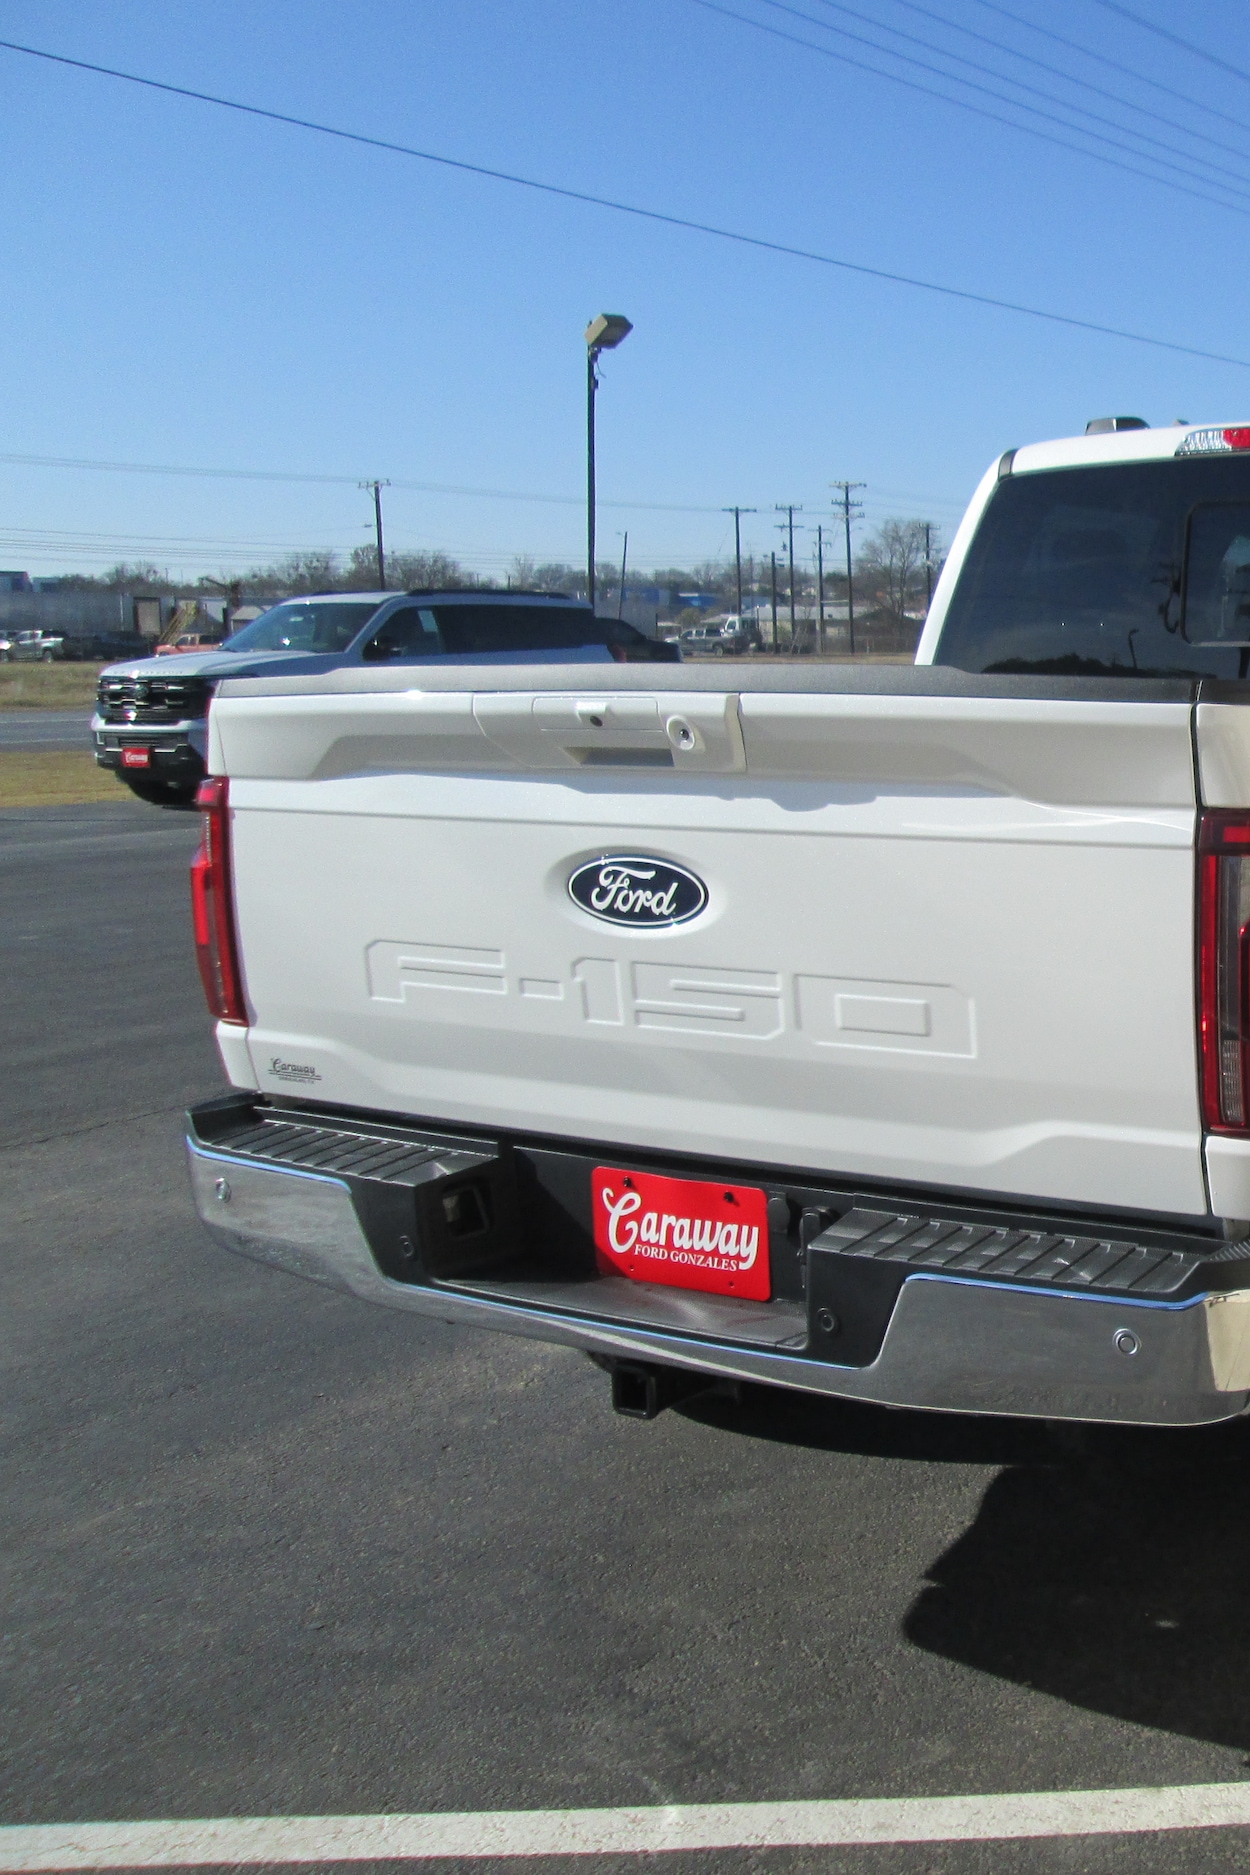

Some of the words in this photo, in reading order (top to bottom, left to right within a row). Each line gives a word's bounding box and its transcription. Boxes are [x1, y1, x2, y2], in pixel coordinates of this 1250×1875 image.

[591, 865, 679, 916] Ford
[365, 939, 977, 1058] F-150
[270, 1057, 316, 1076] Caraway
[602, 1187, 759, 1271] Caraway
[634, 1243, 669, 1261] FORD
[669, 1251, 738, 1273] GONZALES
